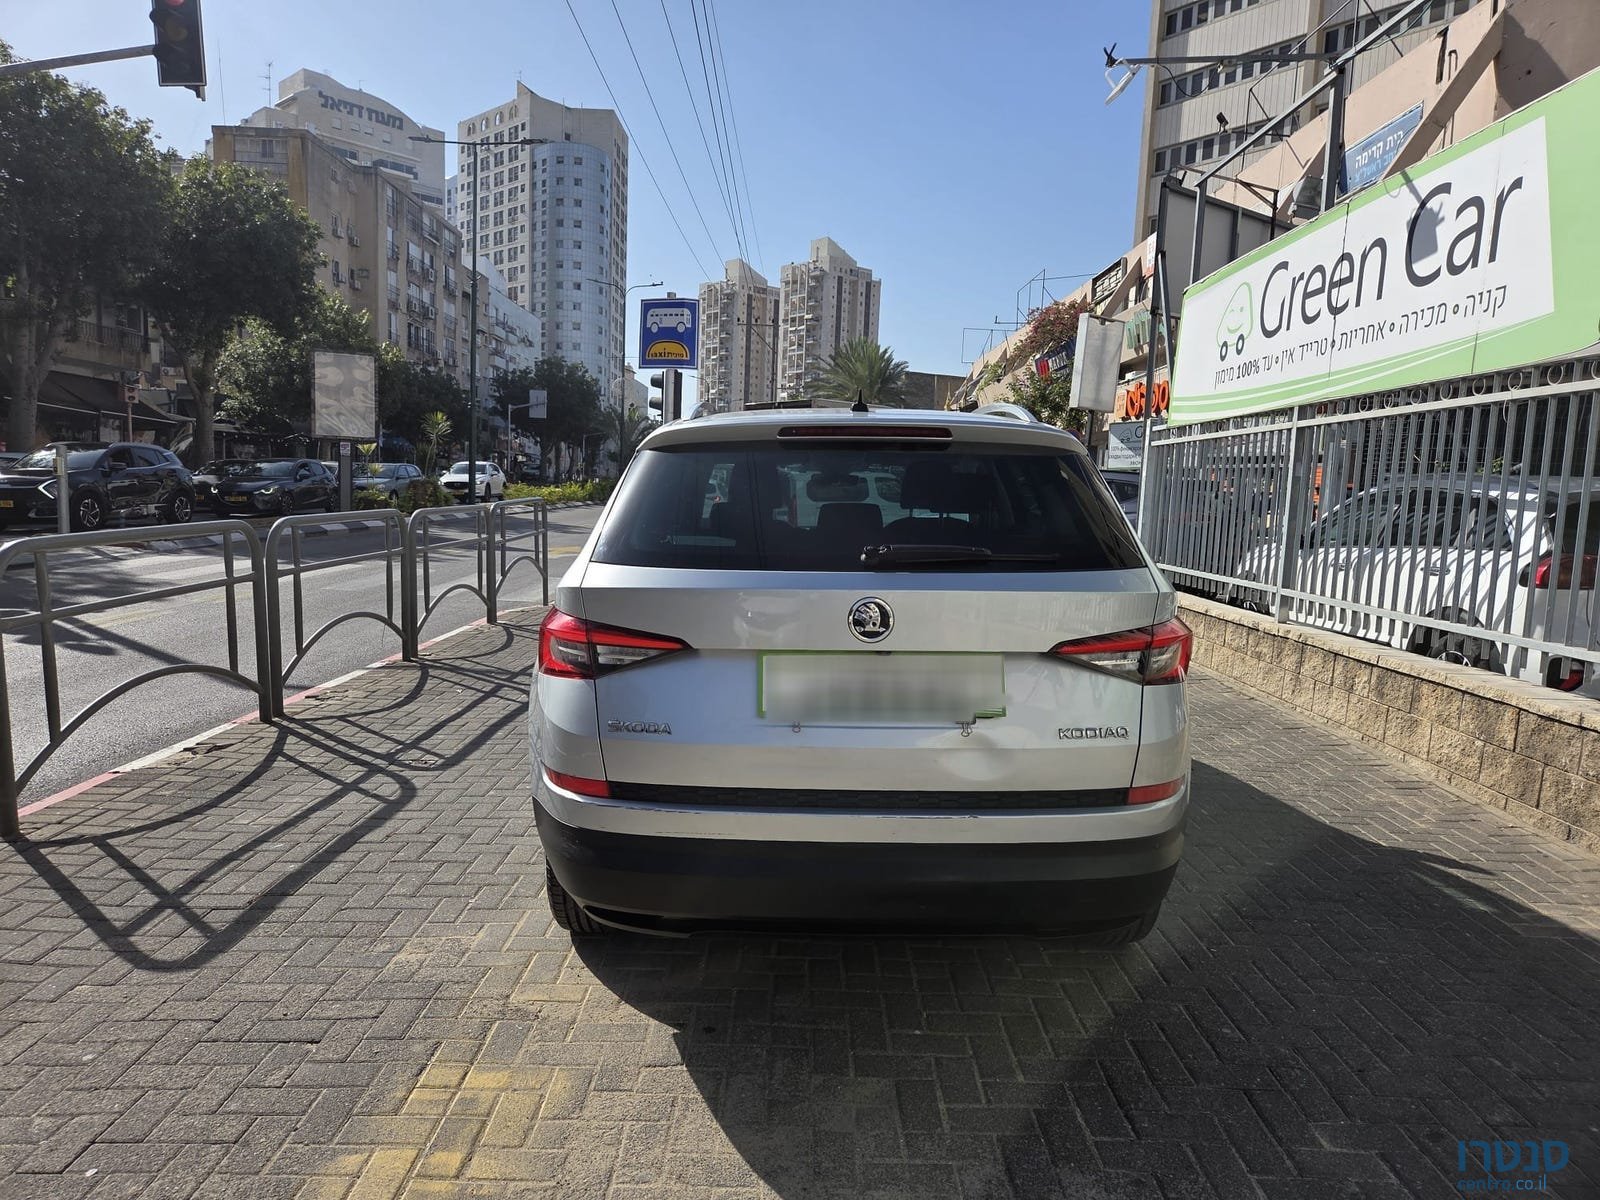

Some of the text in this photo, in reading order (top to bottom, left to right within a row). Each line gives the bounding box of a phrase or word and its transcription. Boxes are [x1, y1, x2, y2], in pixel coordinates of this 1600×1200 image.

[1260, 237, 1387, 338] Green
[1405, 176, 1523, 287] Car
[1214, 285, 1507, 390] קניה מכירה אחריות טרייד אין עד 100% מימון
[1058, 726, 1129, 740] KODIAQ
